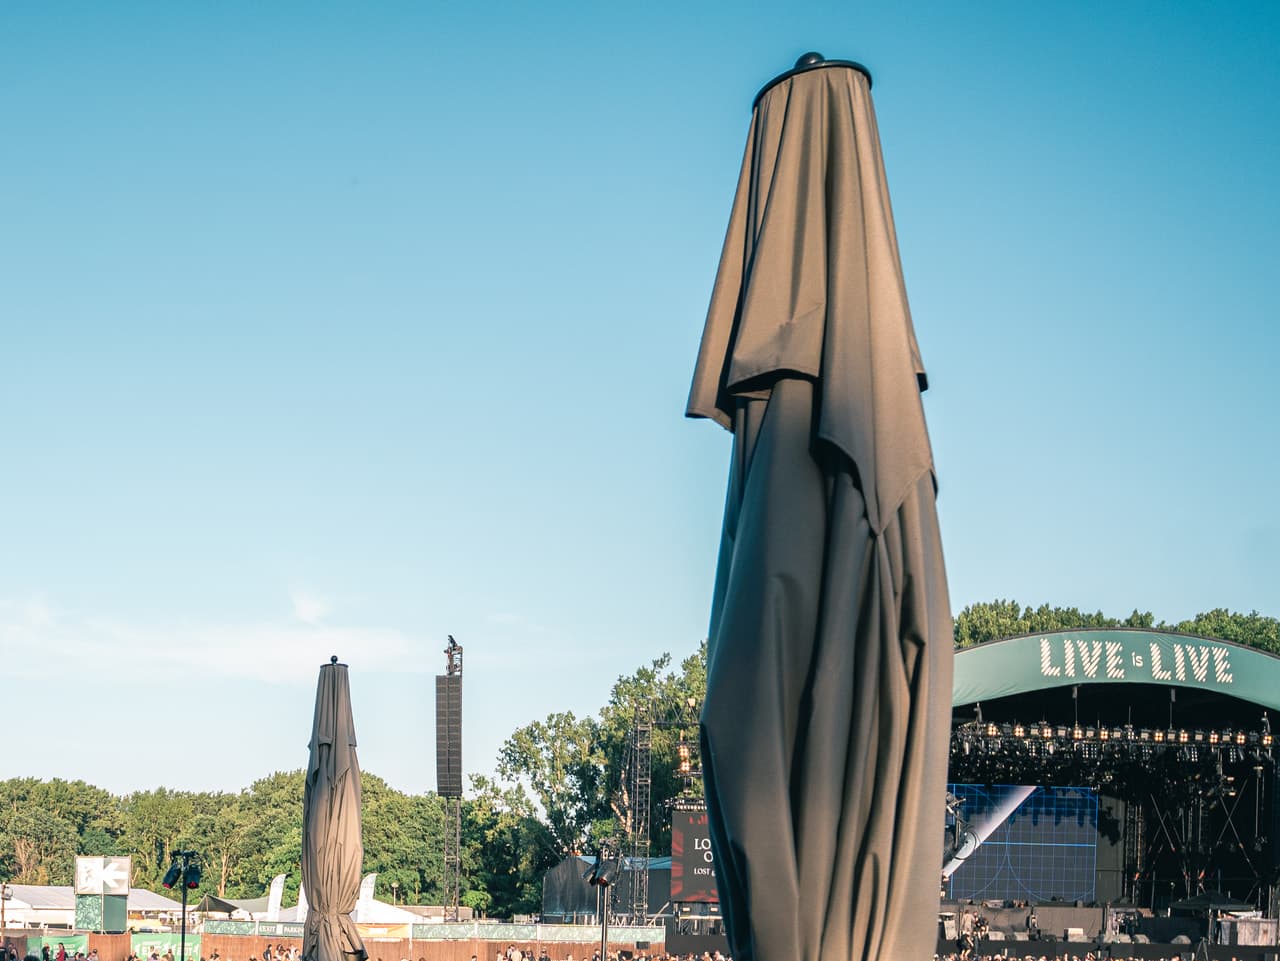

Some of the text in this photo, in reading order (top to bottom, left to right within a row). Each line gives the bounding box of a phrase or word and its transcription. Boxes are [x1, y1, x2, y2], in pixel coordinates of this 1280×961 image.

[1040, 638, 1233, 683] LIVE is LIVE
[693, 867, 710, 876] LOST
